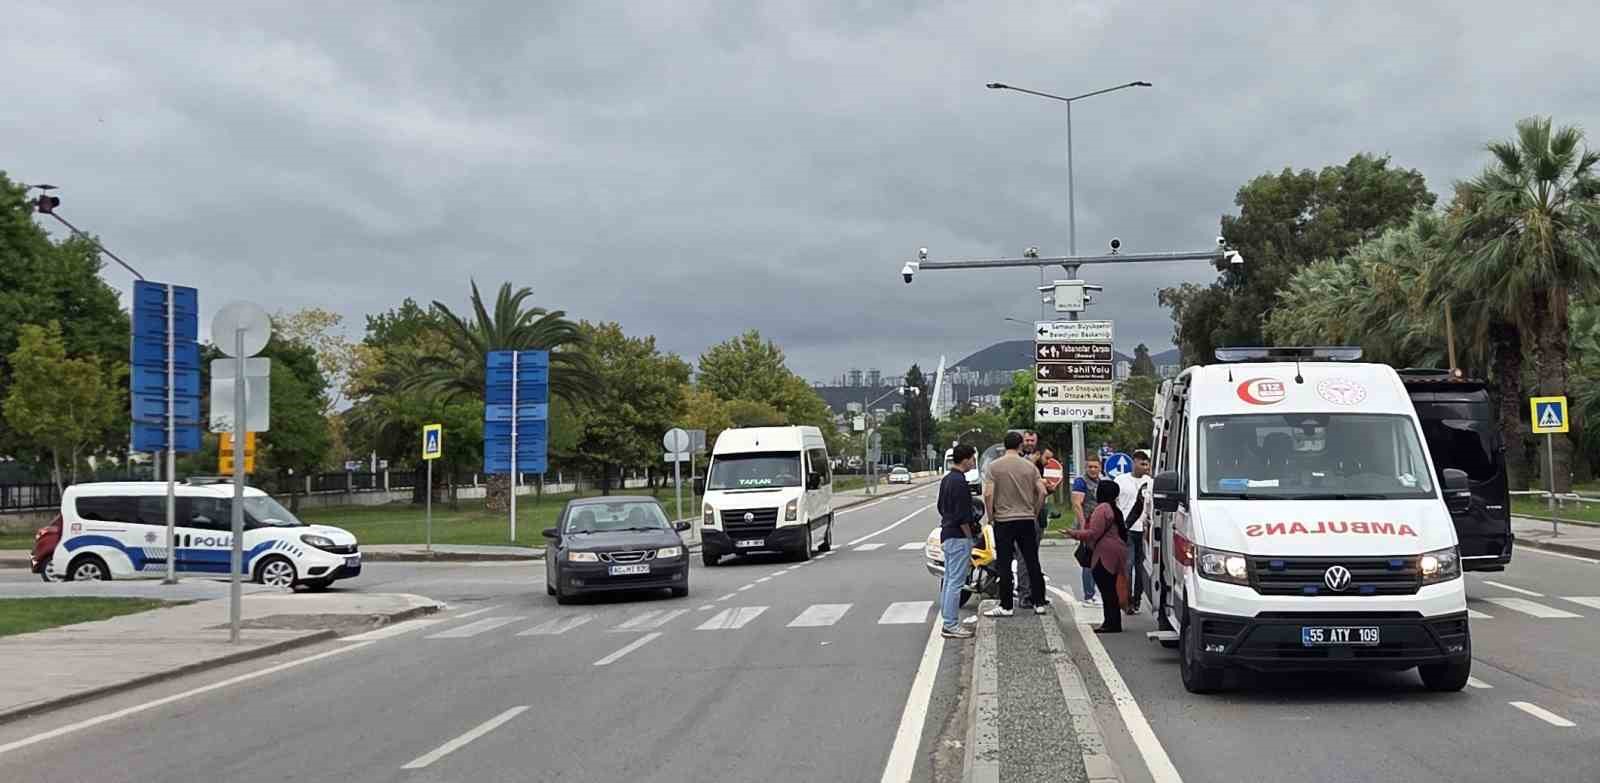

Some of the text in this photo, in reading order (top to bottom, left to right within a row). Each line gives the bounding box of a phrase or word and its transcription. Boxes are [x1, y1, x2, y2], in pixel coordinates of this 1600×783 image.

[1067, 365, 1110, 374] Sahil Yolu
[1053, 407, 1093, 418] Balonya
[1310, 629, 1377, 641] 55 ATY 109
